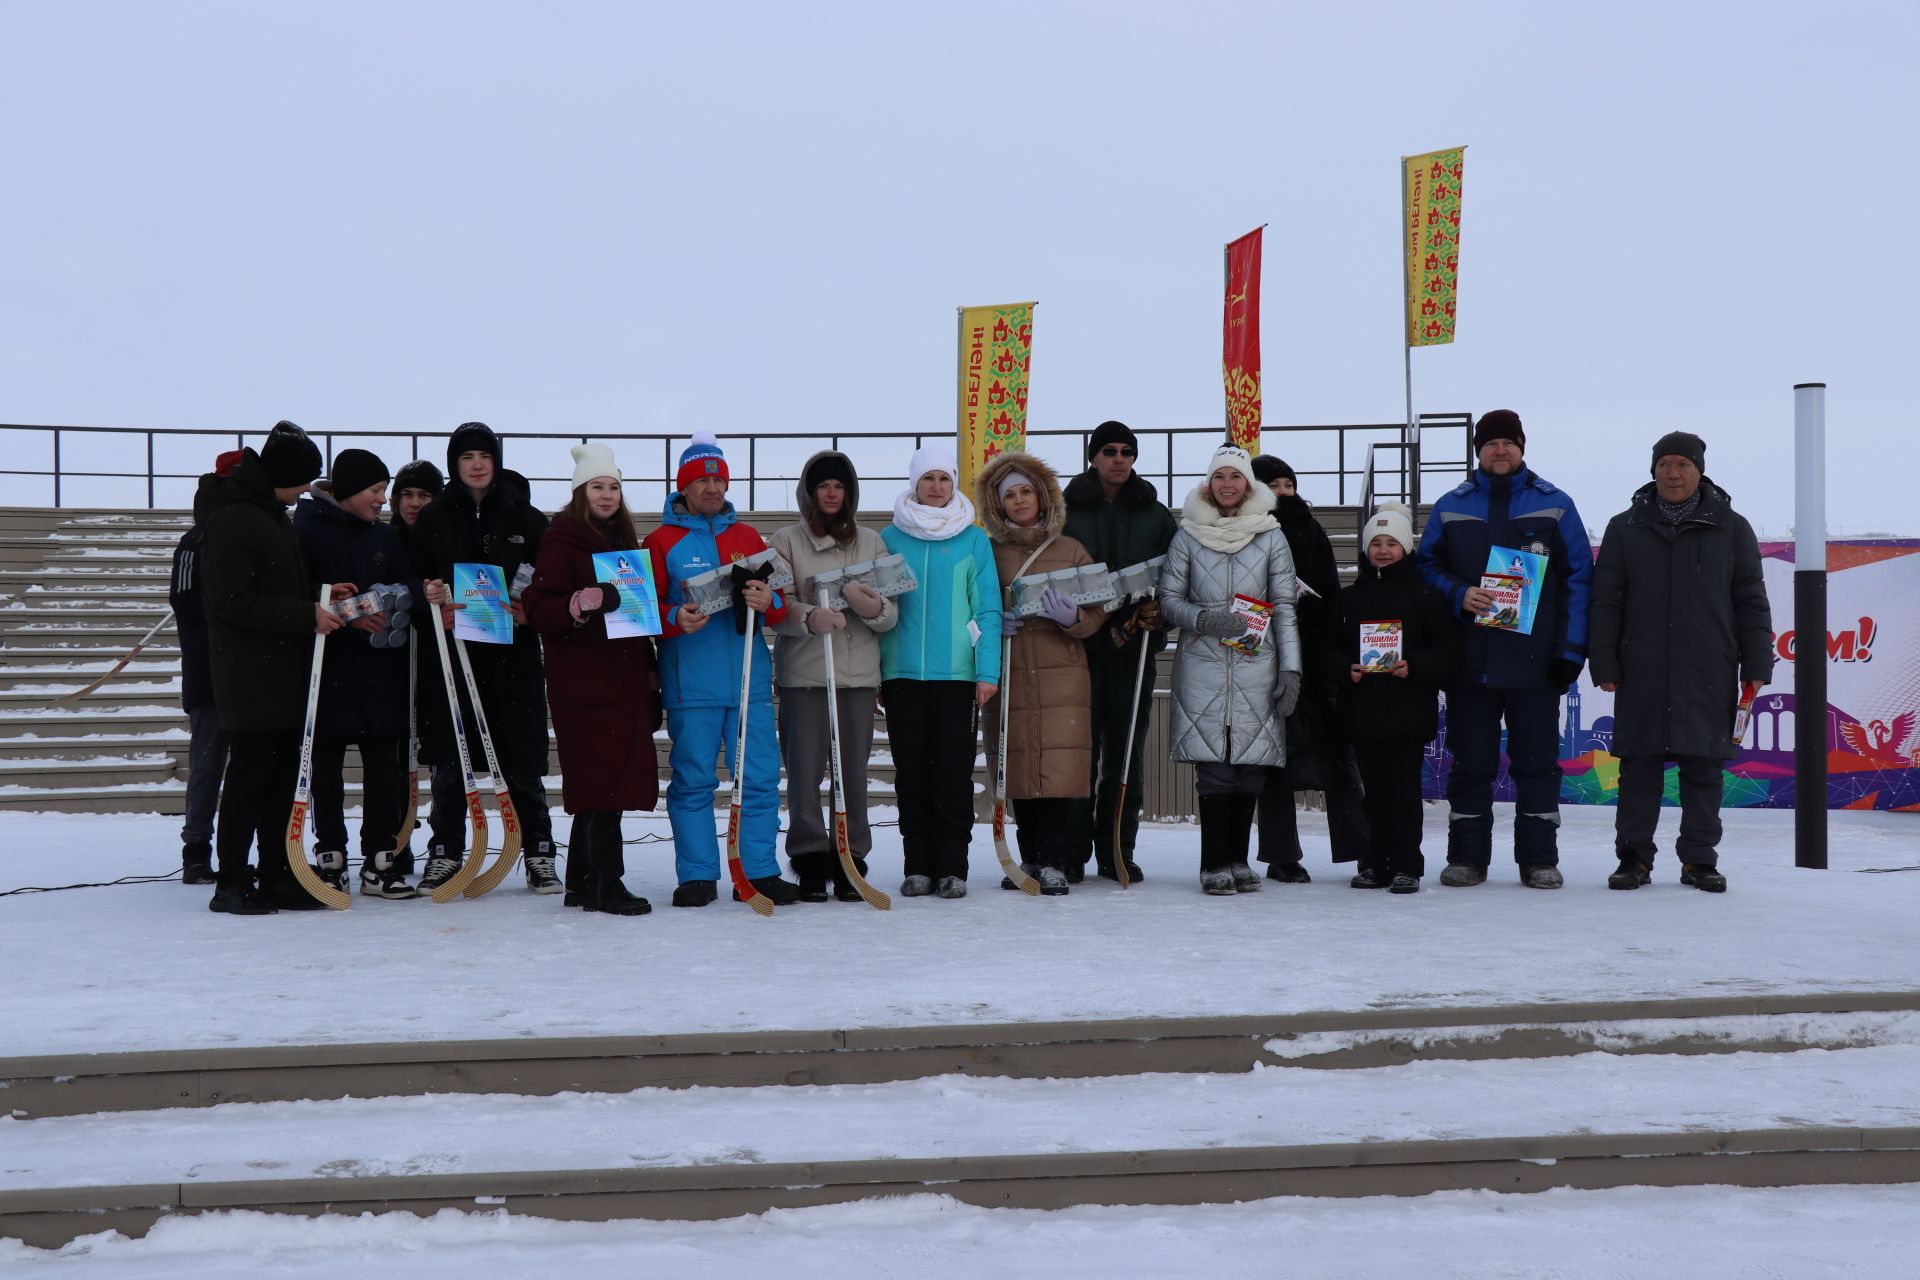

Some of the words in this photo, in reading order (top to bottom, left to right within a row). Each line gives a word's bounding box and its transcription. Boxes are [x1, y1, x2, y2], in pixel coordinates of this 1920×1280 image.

[967, 326, 985, 407] БЕЛӘН!
[465, 589, 502, 597] ДИПЛОМ
[1362, 635, 1399, 643] СУШИЛКА
[289, 807, 305, 842] STEX
[469, 794, 486, 831] STEX
[500, 797, 518, 833] STEX
[728, 812, 739, 846] STEX
[837, 819, 849, 855] STEX
